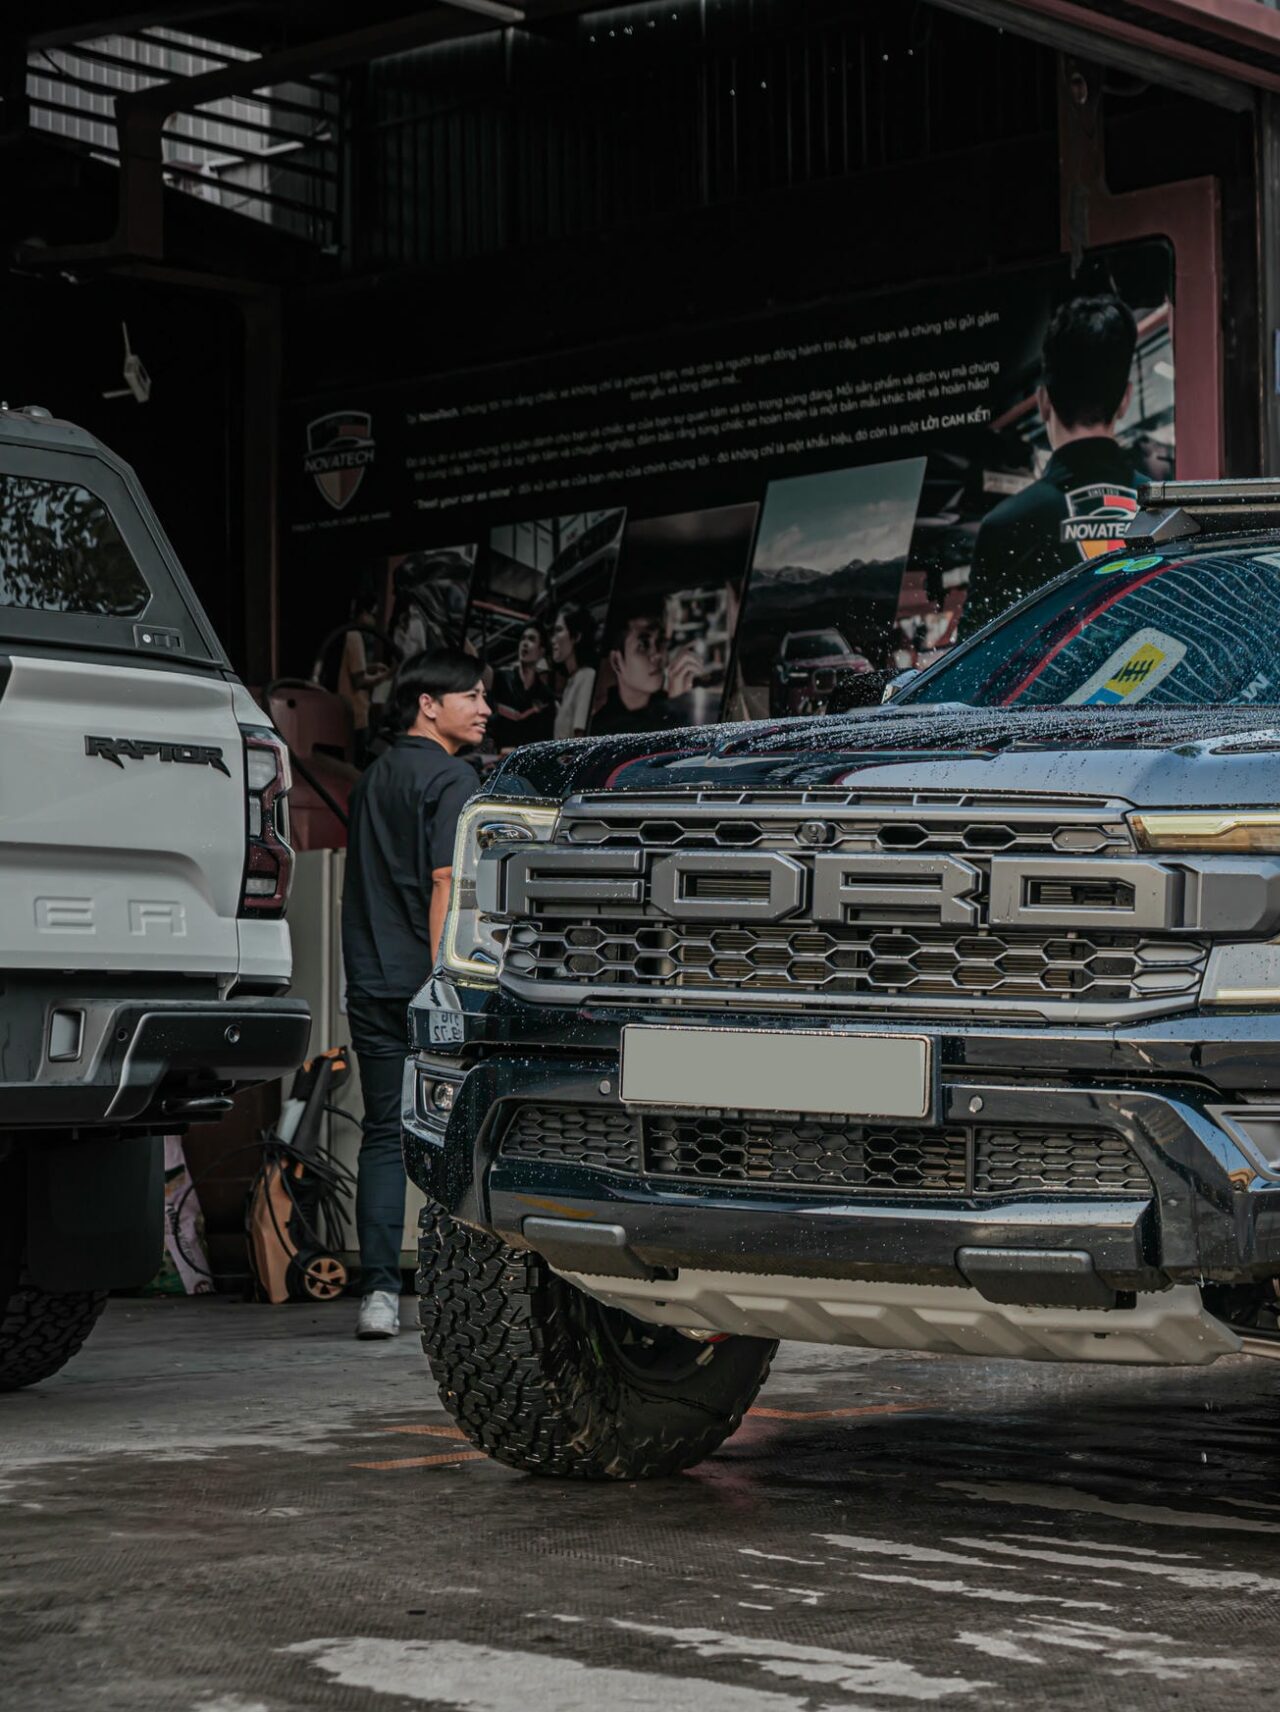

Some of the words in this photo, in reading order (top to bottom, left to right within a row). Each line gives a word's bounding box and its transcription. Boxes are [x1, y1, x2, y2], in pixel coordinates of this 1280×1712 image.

[303, 449, 376, 473] NOVATECH
[84, 735, 231, 777] RAPTOR
[505, 849, 1175, 931] FORD
